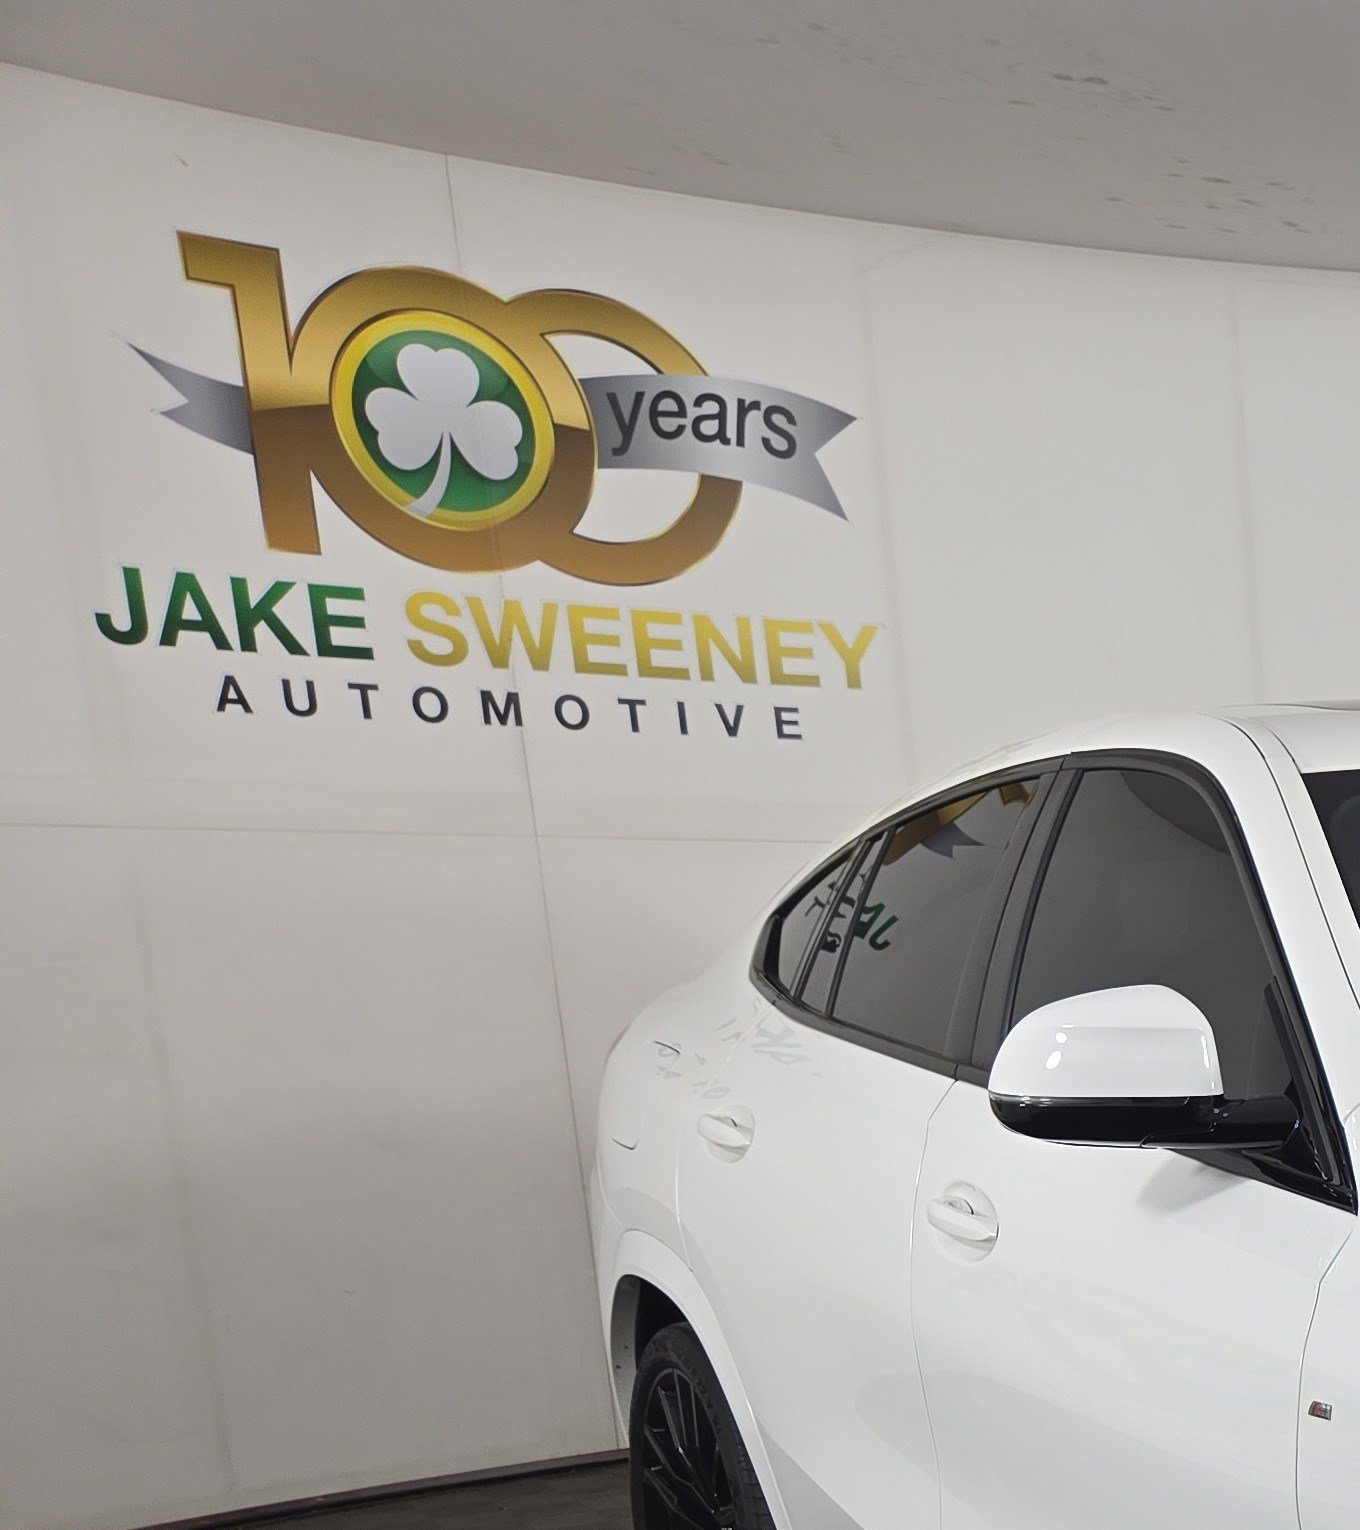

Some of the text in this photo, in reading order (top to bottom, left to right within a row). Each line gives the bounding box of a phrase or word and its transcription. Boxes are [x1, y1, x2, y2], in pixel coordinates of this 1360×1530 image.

[177, 230, 799, 586] 100 years
[94, 566, 877, 689] JAKE SWEENEY
[216, 673, 804, 741] AUTOMOTIVE
